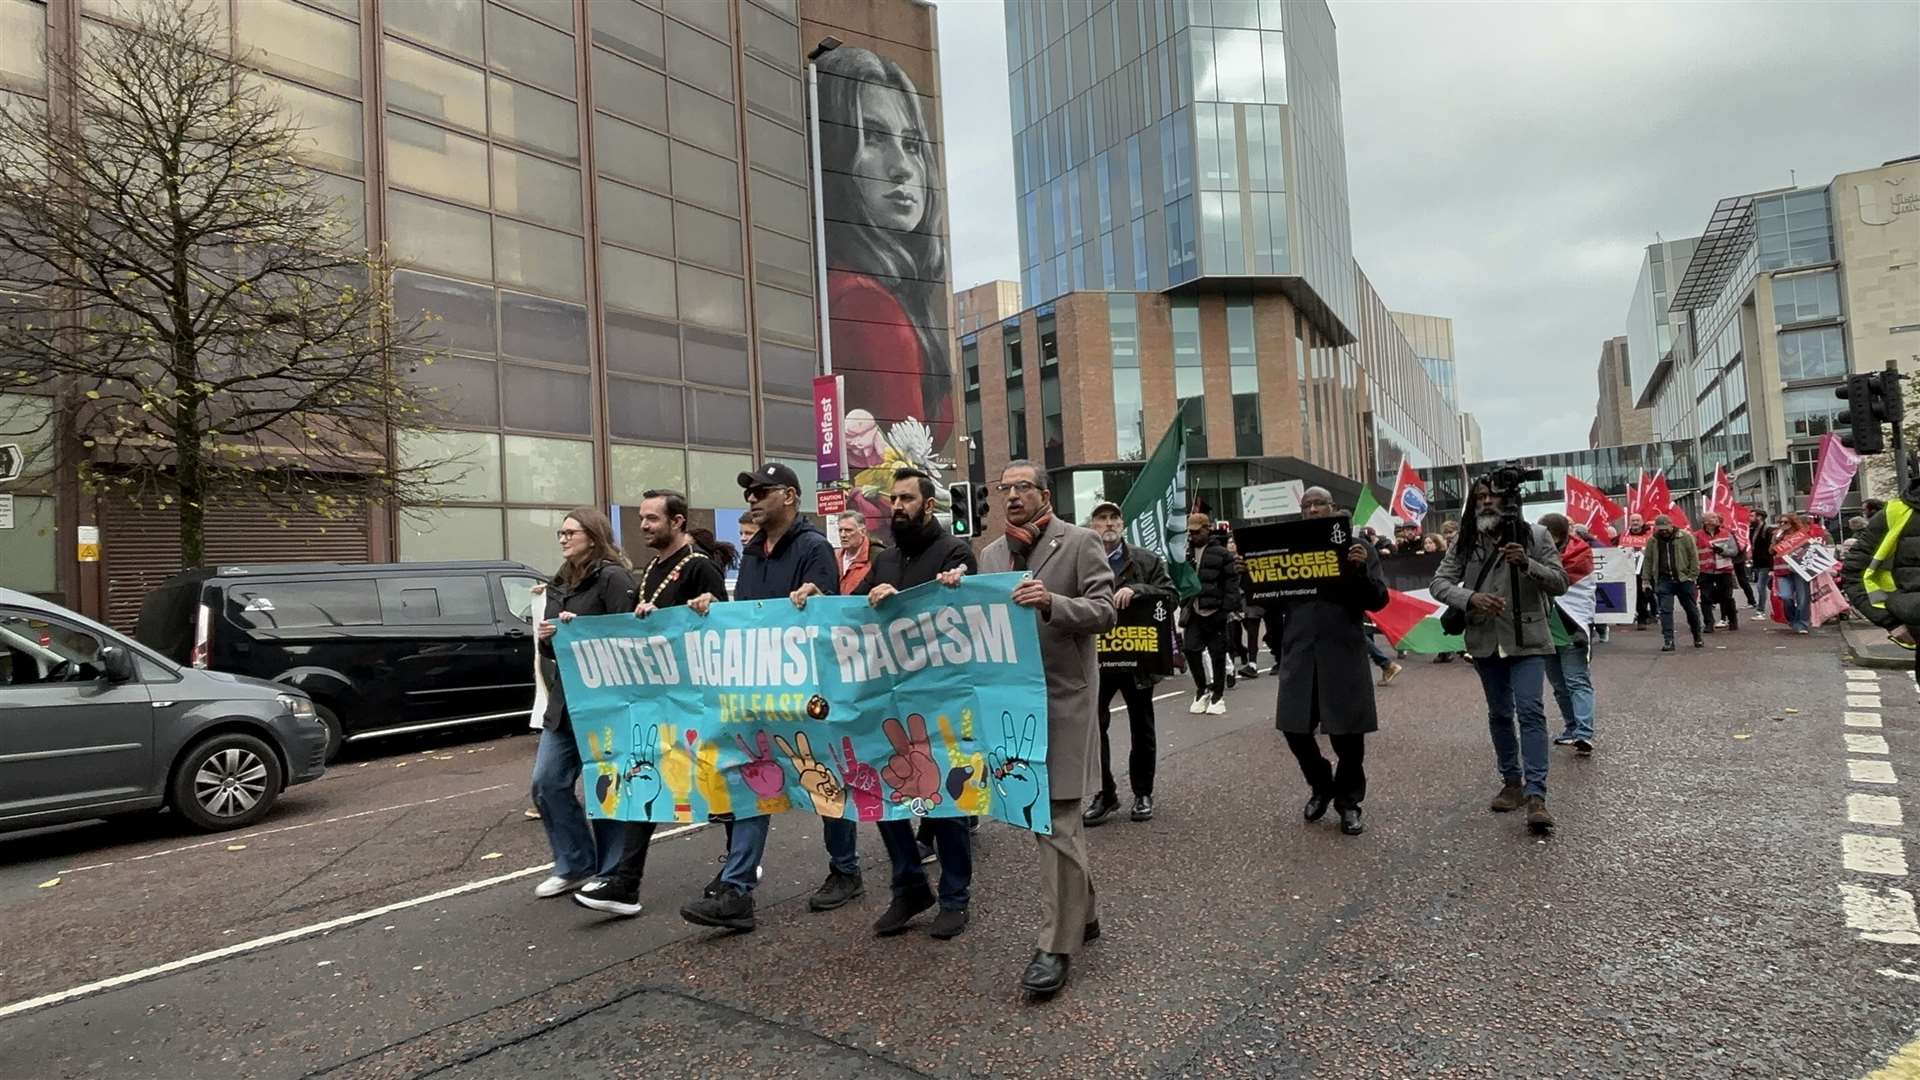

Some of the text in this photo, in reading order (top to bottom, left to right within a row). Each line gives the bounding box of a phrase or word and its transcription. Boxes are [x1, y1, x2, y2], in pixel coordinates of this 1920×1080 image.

[821, 397, 833, 455] Belfast
[1246, 550, 1338, 569] REFUGEES
[1249, 563, 1340, 583] WELCOME
[1253, 591, 1279, 599] Amnesty
[1096, 626, 1158, 640] UGEES
[571, 603, 1018, 688] UNITED AGAINST RACISM
[1096, 639, 1158, 652] ELCOME
[719, 693, 804, 722] BELFAST
